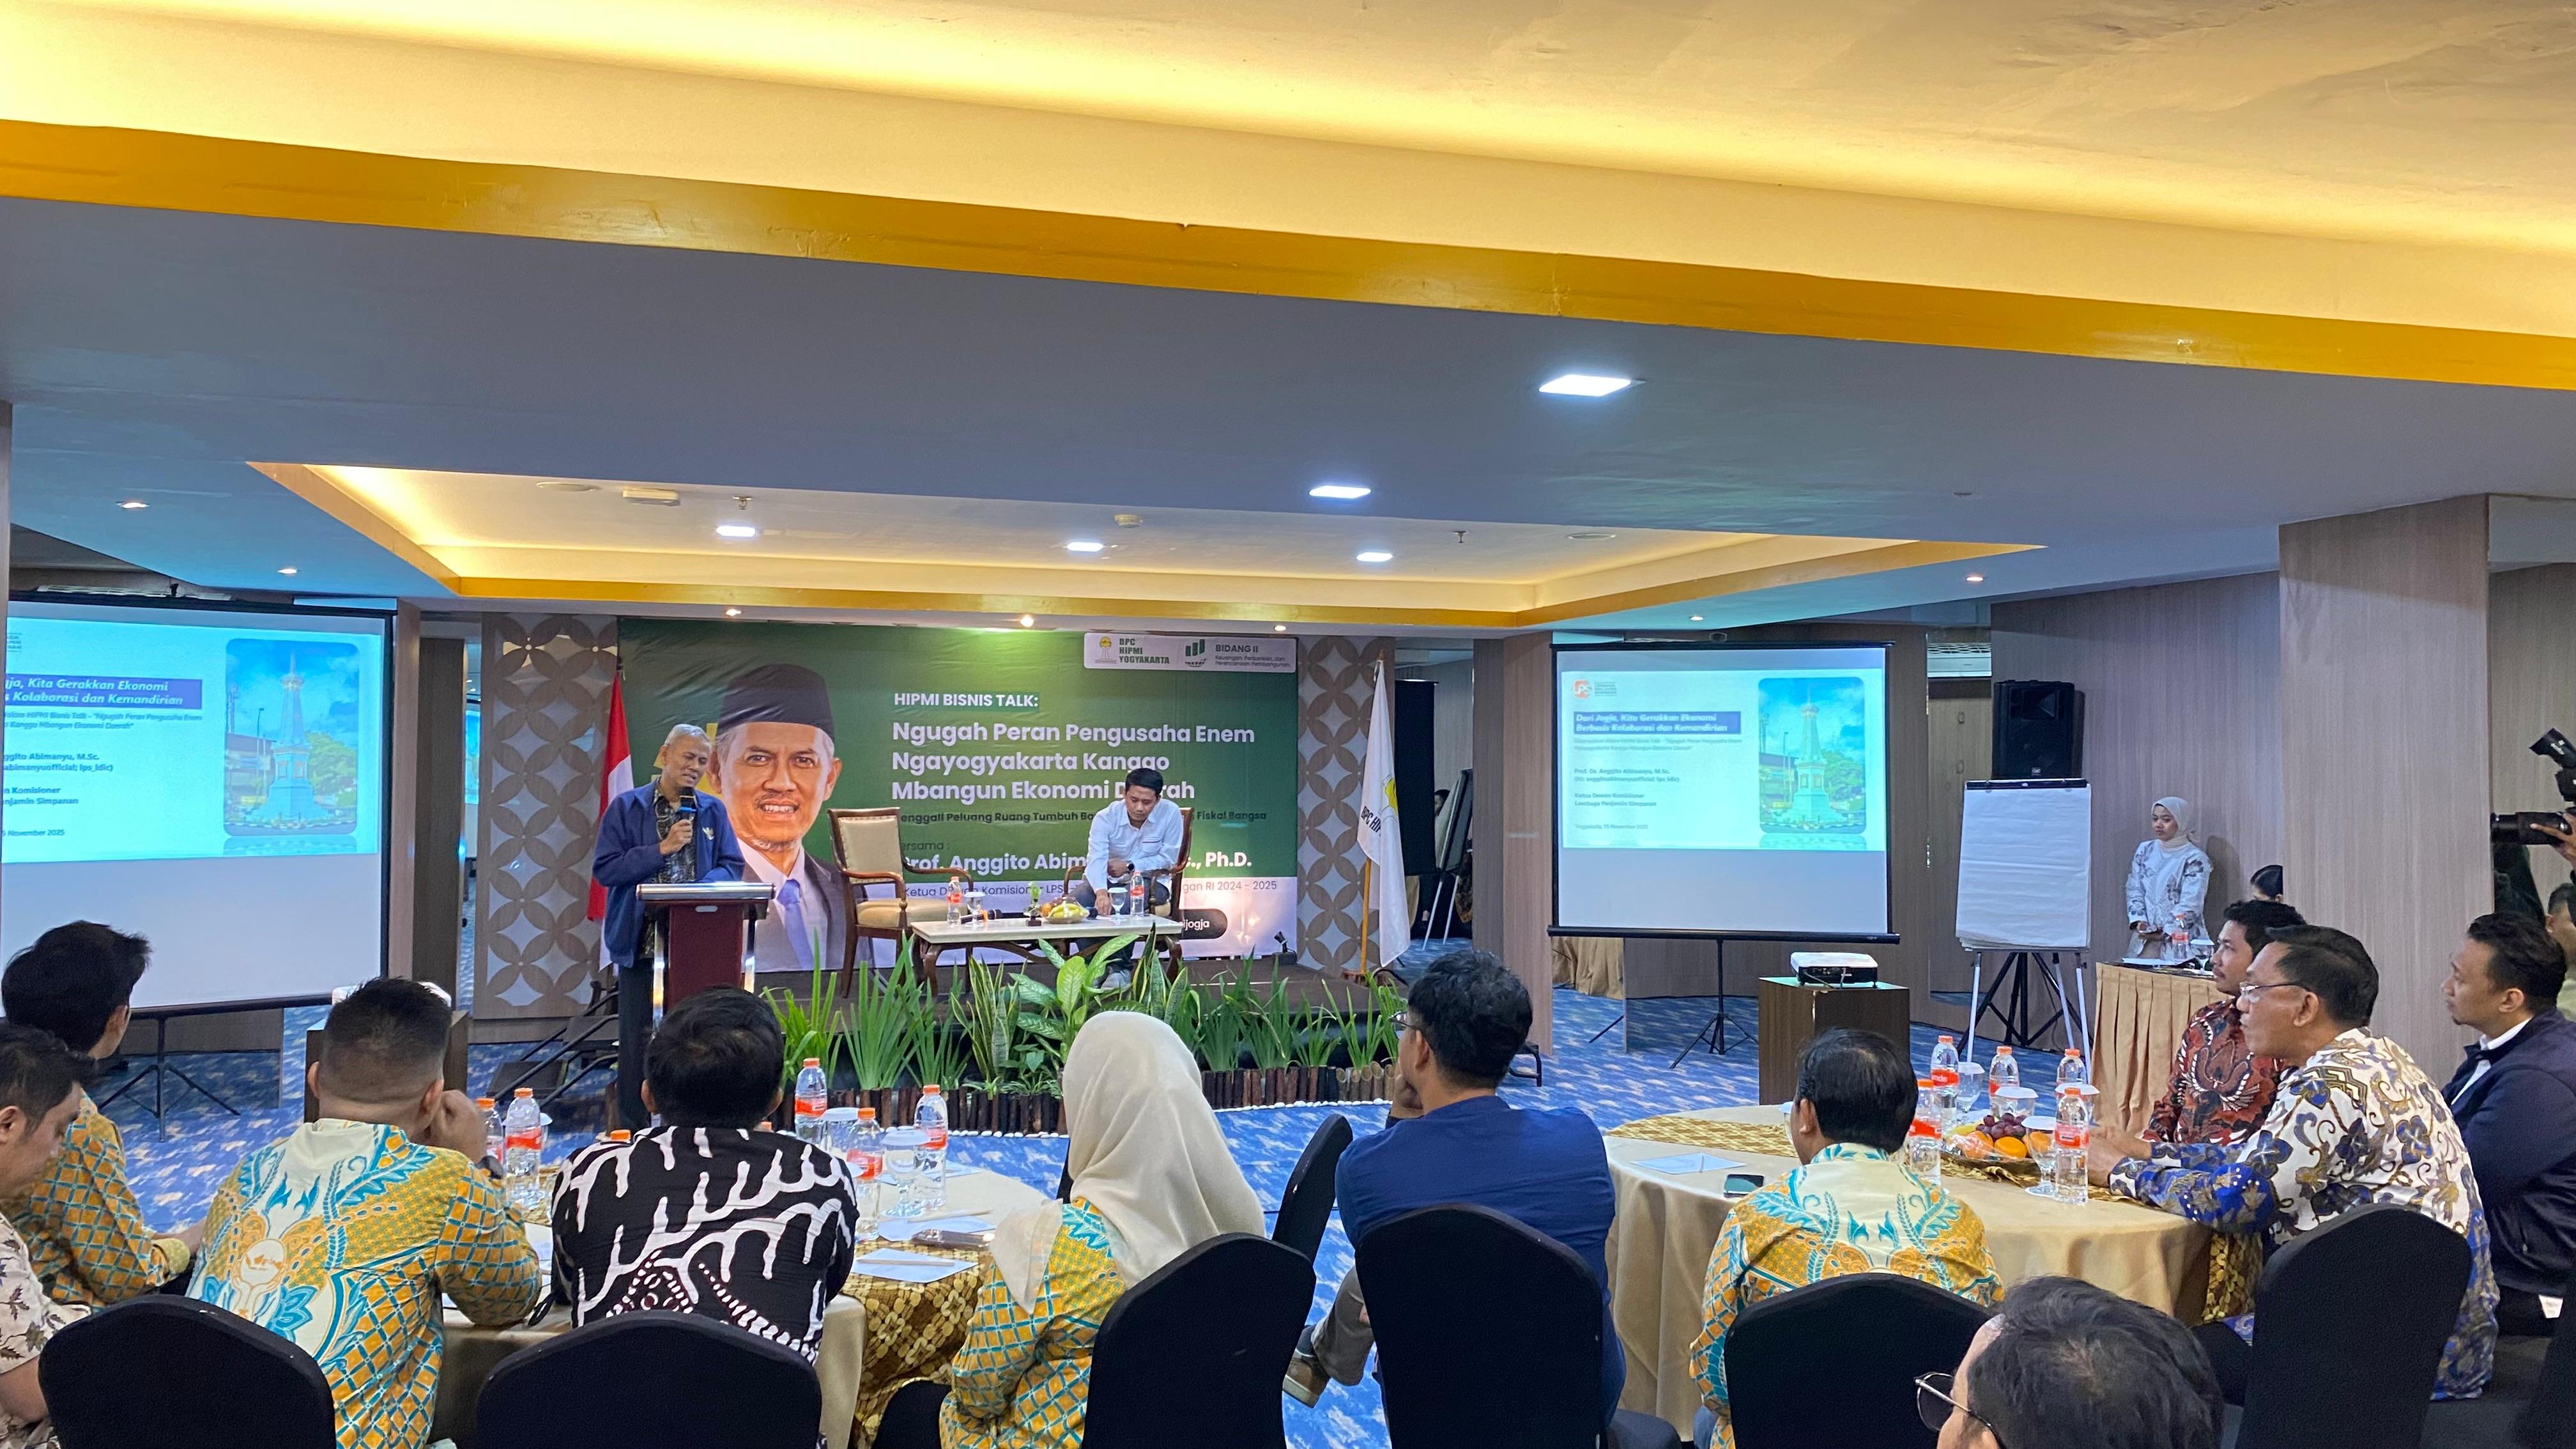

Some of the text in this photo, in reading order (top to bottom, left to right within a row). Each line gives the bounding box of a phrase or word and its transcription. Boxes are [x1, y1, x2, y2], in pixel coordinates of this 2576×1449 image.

[1119, 656, 1170, 664] YOGYAKARTA
[28, 678, 53, 688] Kita
[56, 678, 114, 691] Gerakkan
[118, 680, 168, 691] Ekonomi
[13, 691, 79, 703] Kolaborasi
[82, 693, 105, 703] dan
[108, 693, 183, 705] Kemandirian
[894, 693, 1039, 707] HIPMI BISNIS TALK:
[893, 722, 1255, 747] Ngugah Peran Pengusaha Enem
[29, 753, 75, 762] Abimanyu,
[892, 752, 1170, 776] Ngayogyakarta Kanggo
[892, 780, 1195, 805] Mbangun Ekonomi Drah
[900, 812, 944, 825] enggali
[946, 812, 992, 824] Peluang
[994, 813, 1031, 824] Ruang
[1033, 811, 1078, 821] Tumbuh
[1197, 811, 1226, 820] Fiskal
[1229, 811, 1267, 822] Bangsa
[1361, 806, 1374, 825] BPC
[900, 842, 944, 850] ersama
[949, 852, 1030, 876] Anggito
[1034, 852, 1087, 870] Abim
[1205, 852, 1252, 868] Ph.D.
[1046, 884, 1063, 894] LPS
[1206, 882, 1215, 891] RI
[1217, 881, 1242, 891] 2024
[1253, 880, 1277, 890] 2025
